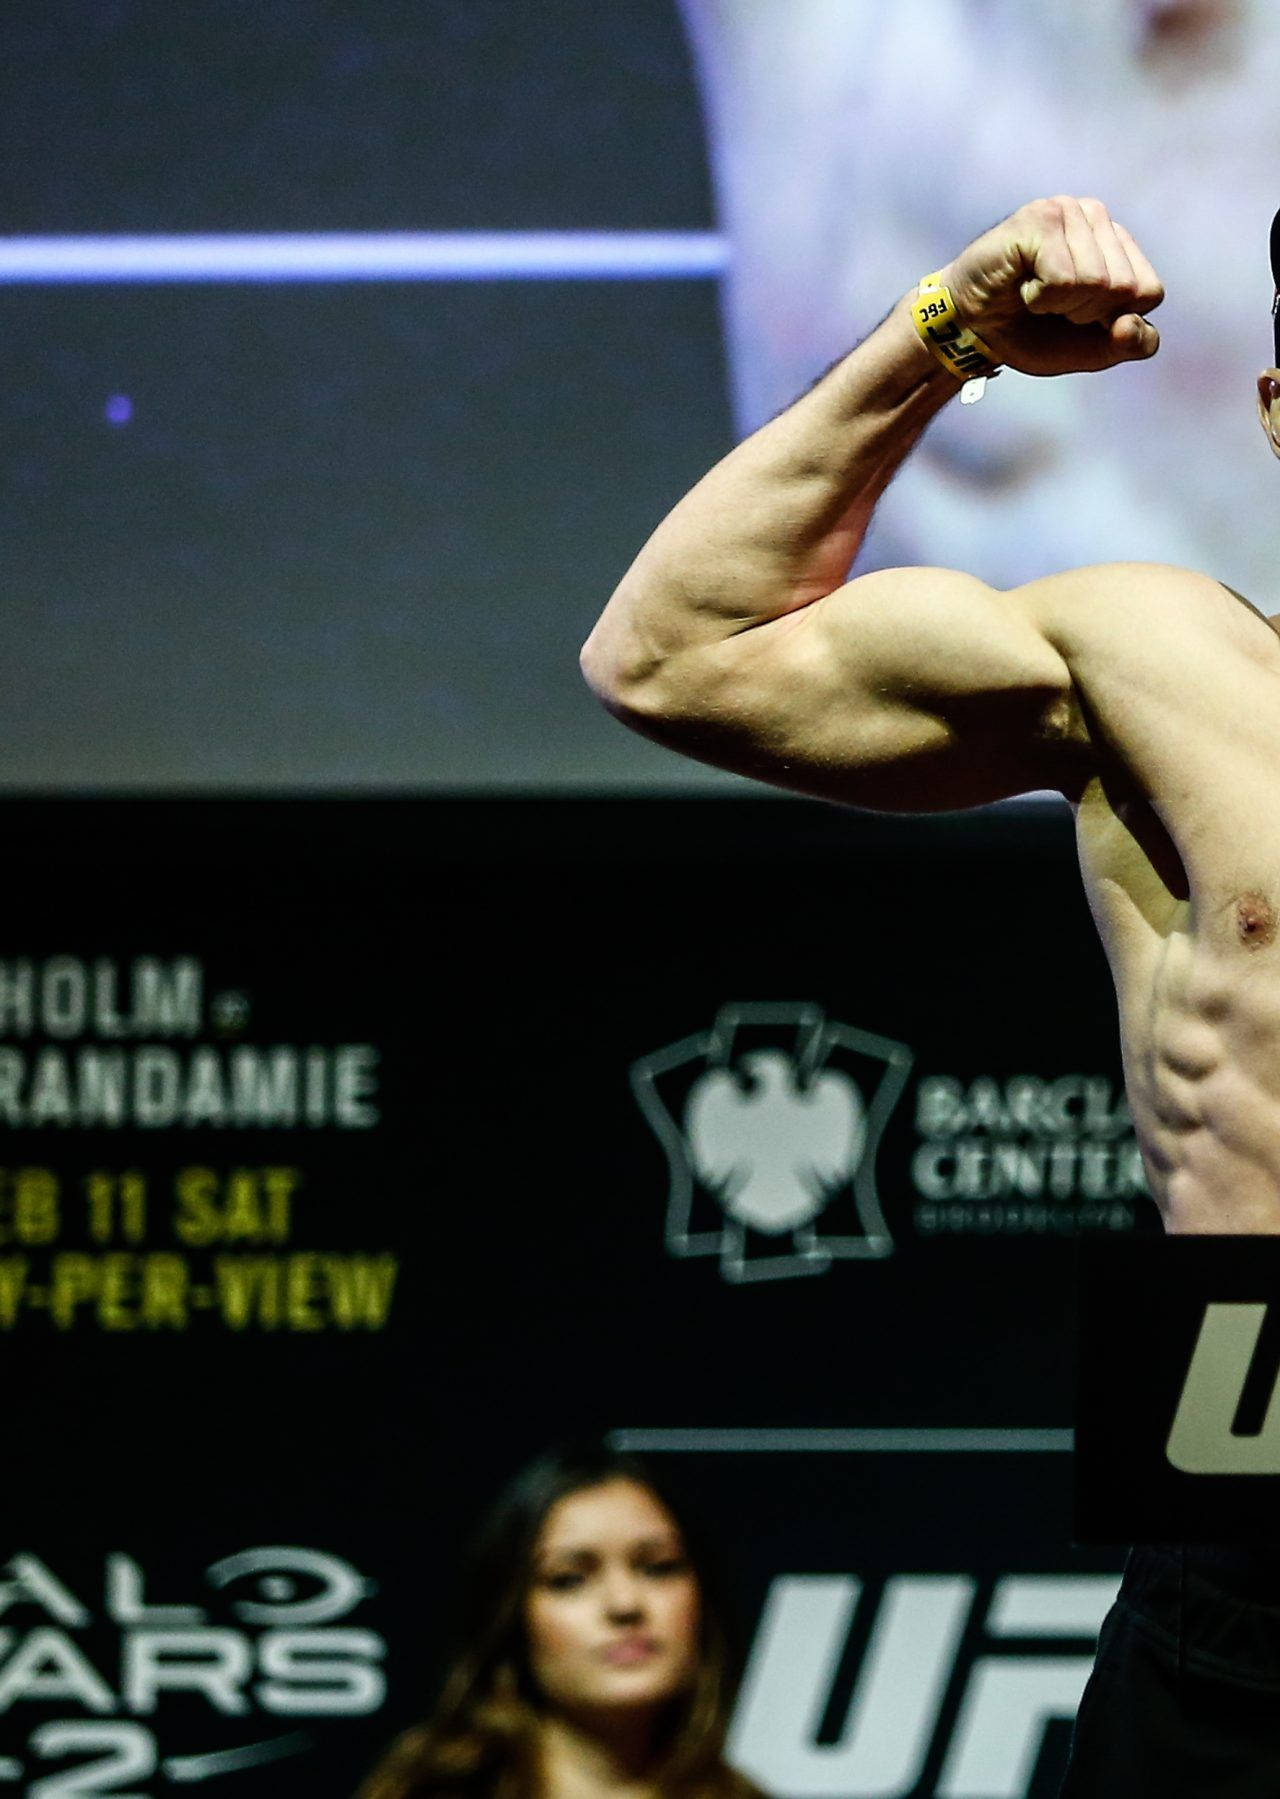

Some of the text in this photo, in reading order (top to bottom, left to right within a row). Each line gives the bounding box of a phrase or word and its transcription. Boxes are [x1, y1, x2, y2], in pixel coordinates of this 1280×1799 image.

[0, 954, 203, 1039] HOLM
[0, 1045, 381, 1128] RANDAMIE
[917, 1075, 1134, 1139] BARCL
[175, 1168, 300, 1244] SAT
[0, 1625, 388, 1717] ARS
[722, 1572, 1126, 1799] UF
[27, 1717, 159, 1799] 2
